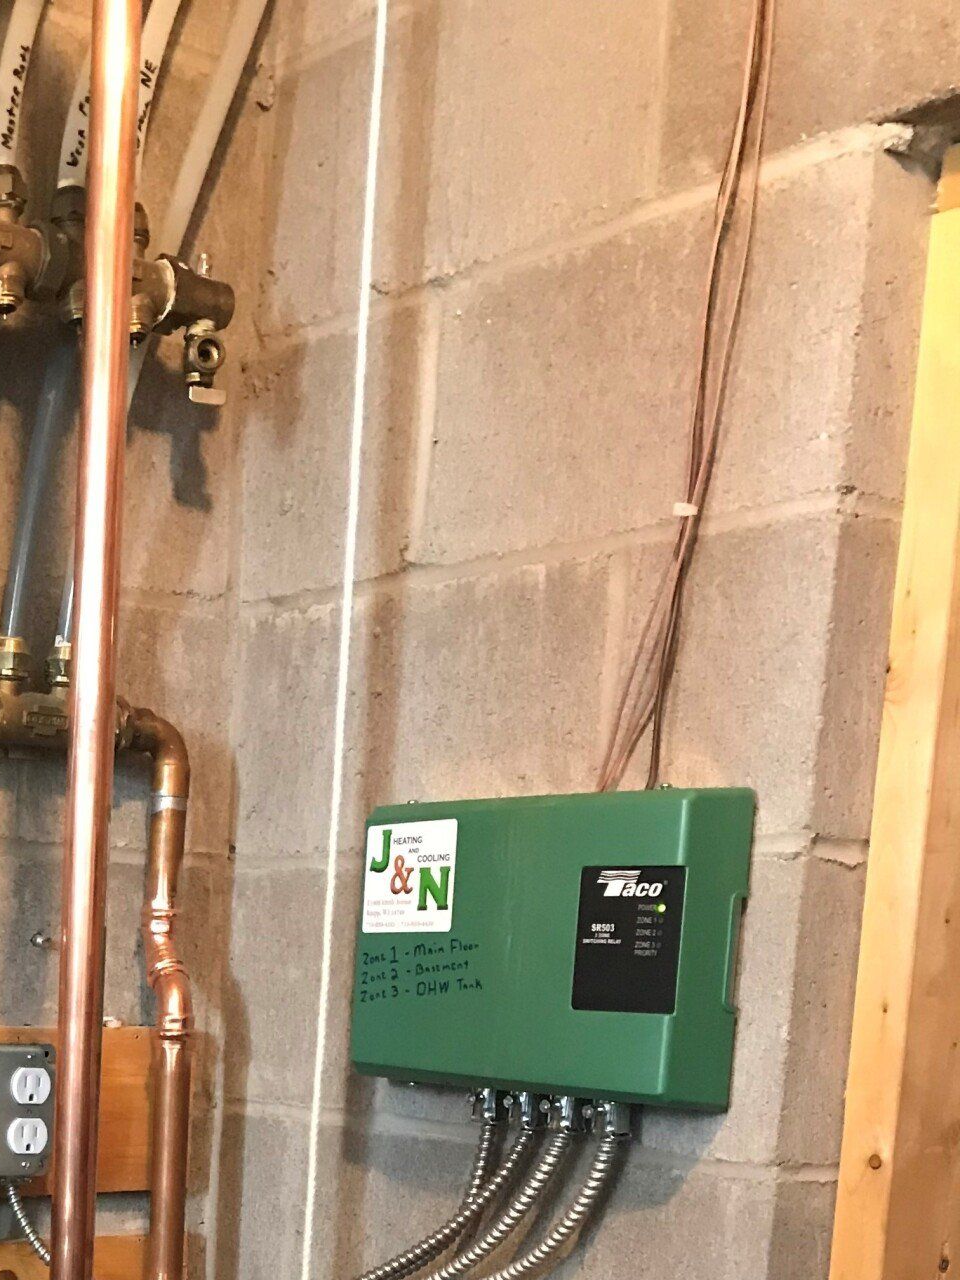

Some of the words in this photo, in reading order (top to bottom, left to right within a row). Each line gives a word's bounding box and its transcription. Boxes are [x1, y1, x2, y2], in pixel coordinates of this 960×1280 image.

[140, 58, 157, 90] NE
[1, 86, 21, 150] Master
[393, 836, 423, 845] HEATING
[370, 829, 393, 873] J
[390, 855, 415, 895] &
[417, 866, 451, 911] N
[417, 853, 451, 863] COOLING
[597, 870, 663, 897] Taco
[591, 923, 615, 932] SR503
[363, 952, 386, 965] Zone
[390, 946, 398, 963] 1
[414, 942, 445, 957] Main
[450, 939, 479, 953] Floor
[361, 971, 386, 985] Zone
[391, 968, 398, 980] 2
[415, 960, 469, 975] Basement
[360, 990, 387, 1002] Zone
[391, 985, 399, 997] 3
